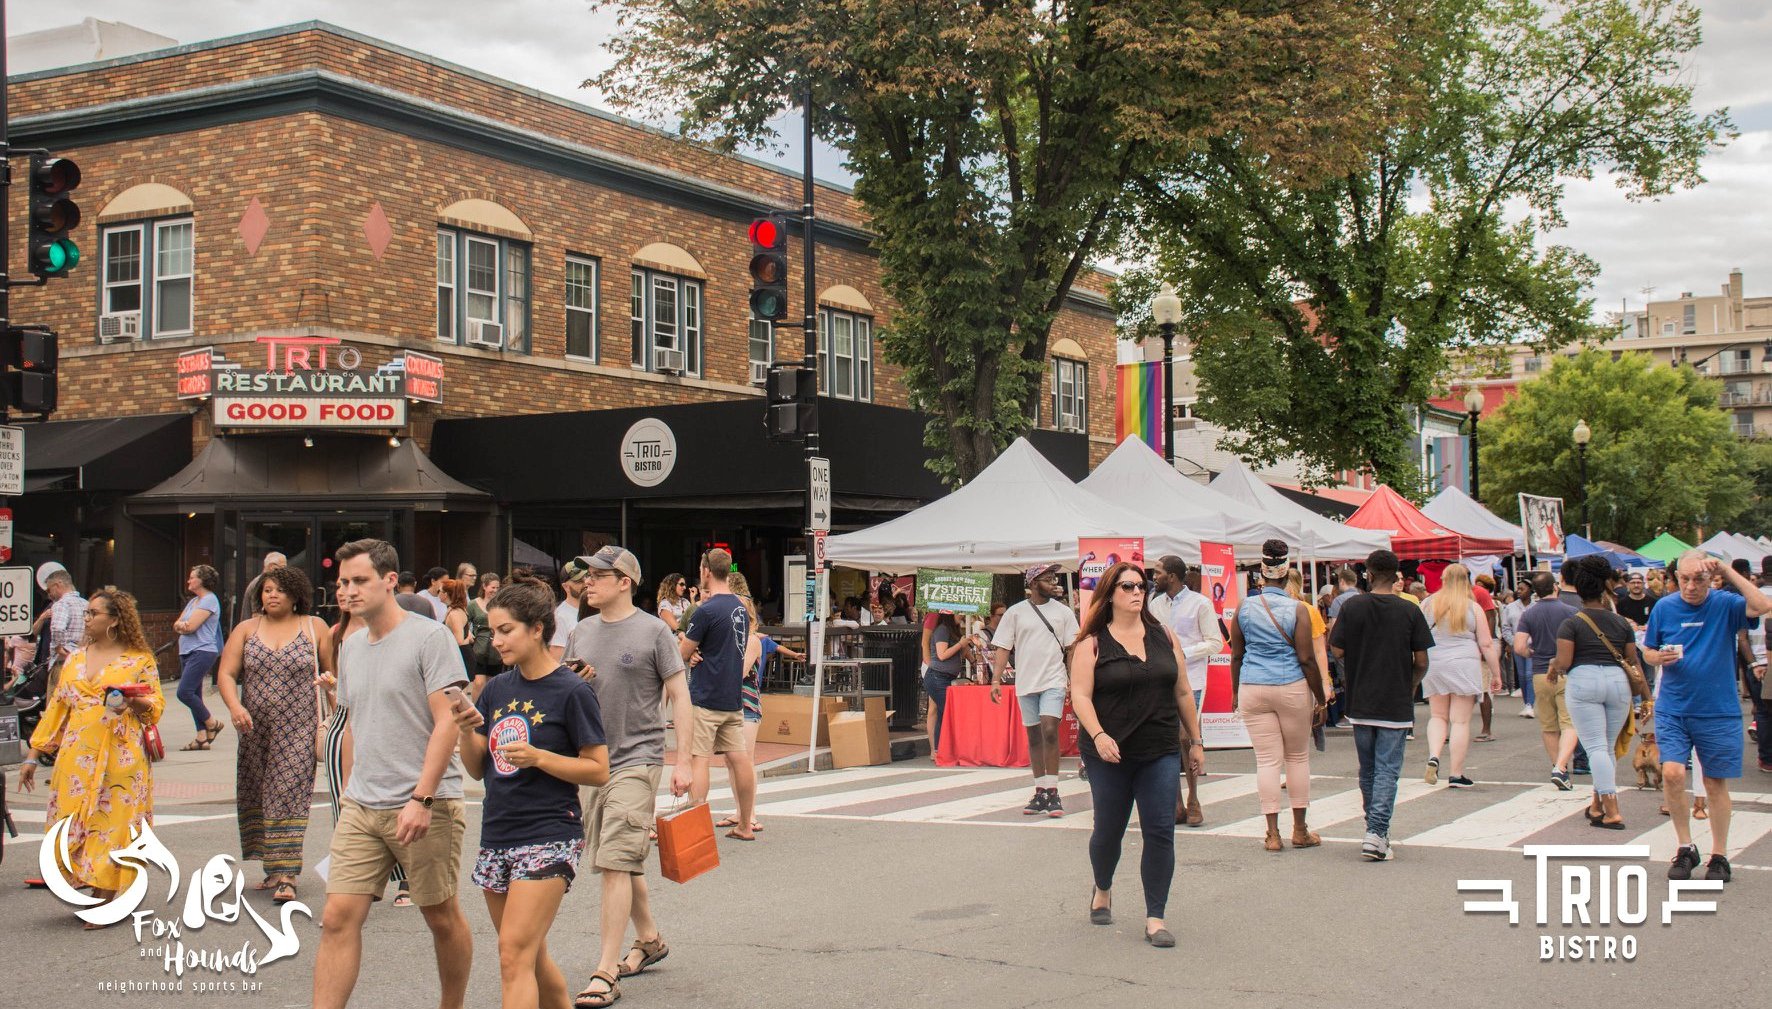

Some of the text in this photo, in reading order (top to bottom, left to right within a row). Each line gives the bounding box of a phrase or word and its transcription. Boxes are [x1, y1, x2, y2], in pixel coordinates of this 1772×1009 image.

[256, 337, 362, 371] TRIO
[217, 374, 401, 393] RESTAURANT
[227, 403, 394, 420] GOOD FOOD
[2, 431, 11, 440] NO
[632, 440, 661, 458] TRIO
[635, 461, 662, 471] BISTRO
[812, 466, 828, 482] ONE
[812, 486, 829, 501] WAY
[0, 581, 14, 598] O
[941, 585, 989, 596] STREET
[940, 594, 988, 603] FESTIVAL
[0, 604, 29, 622] SES
[492, 719, 527, 741] FC BAYERN
